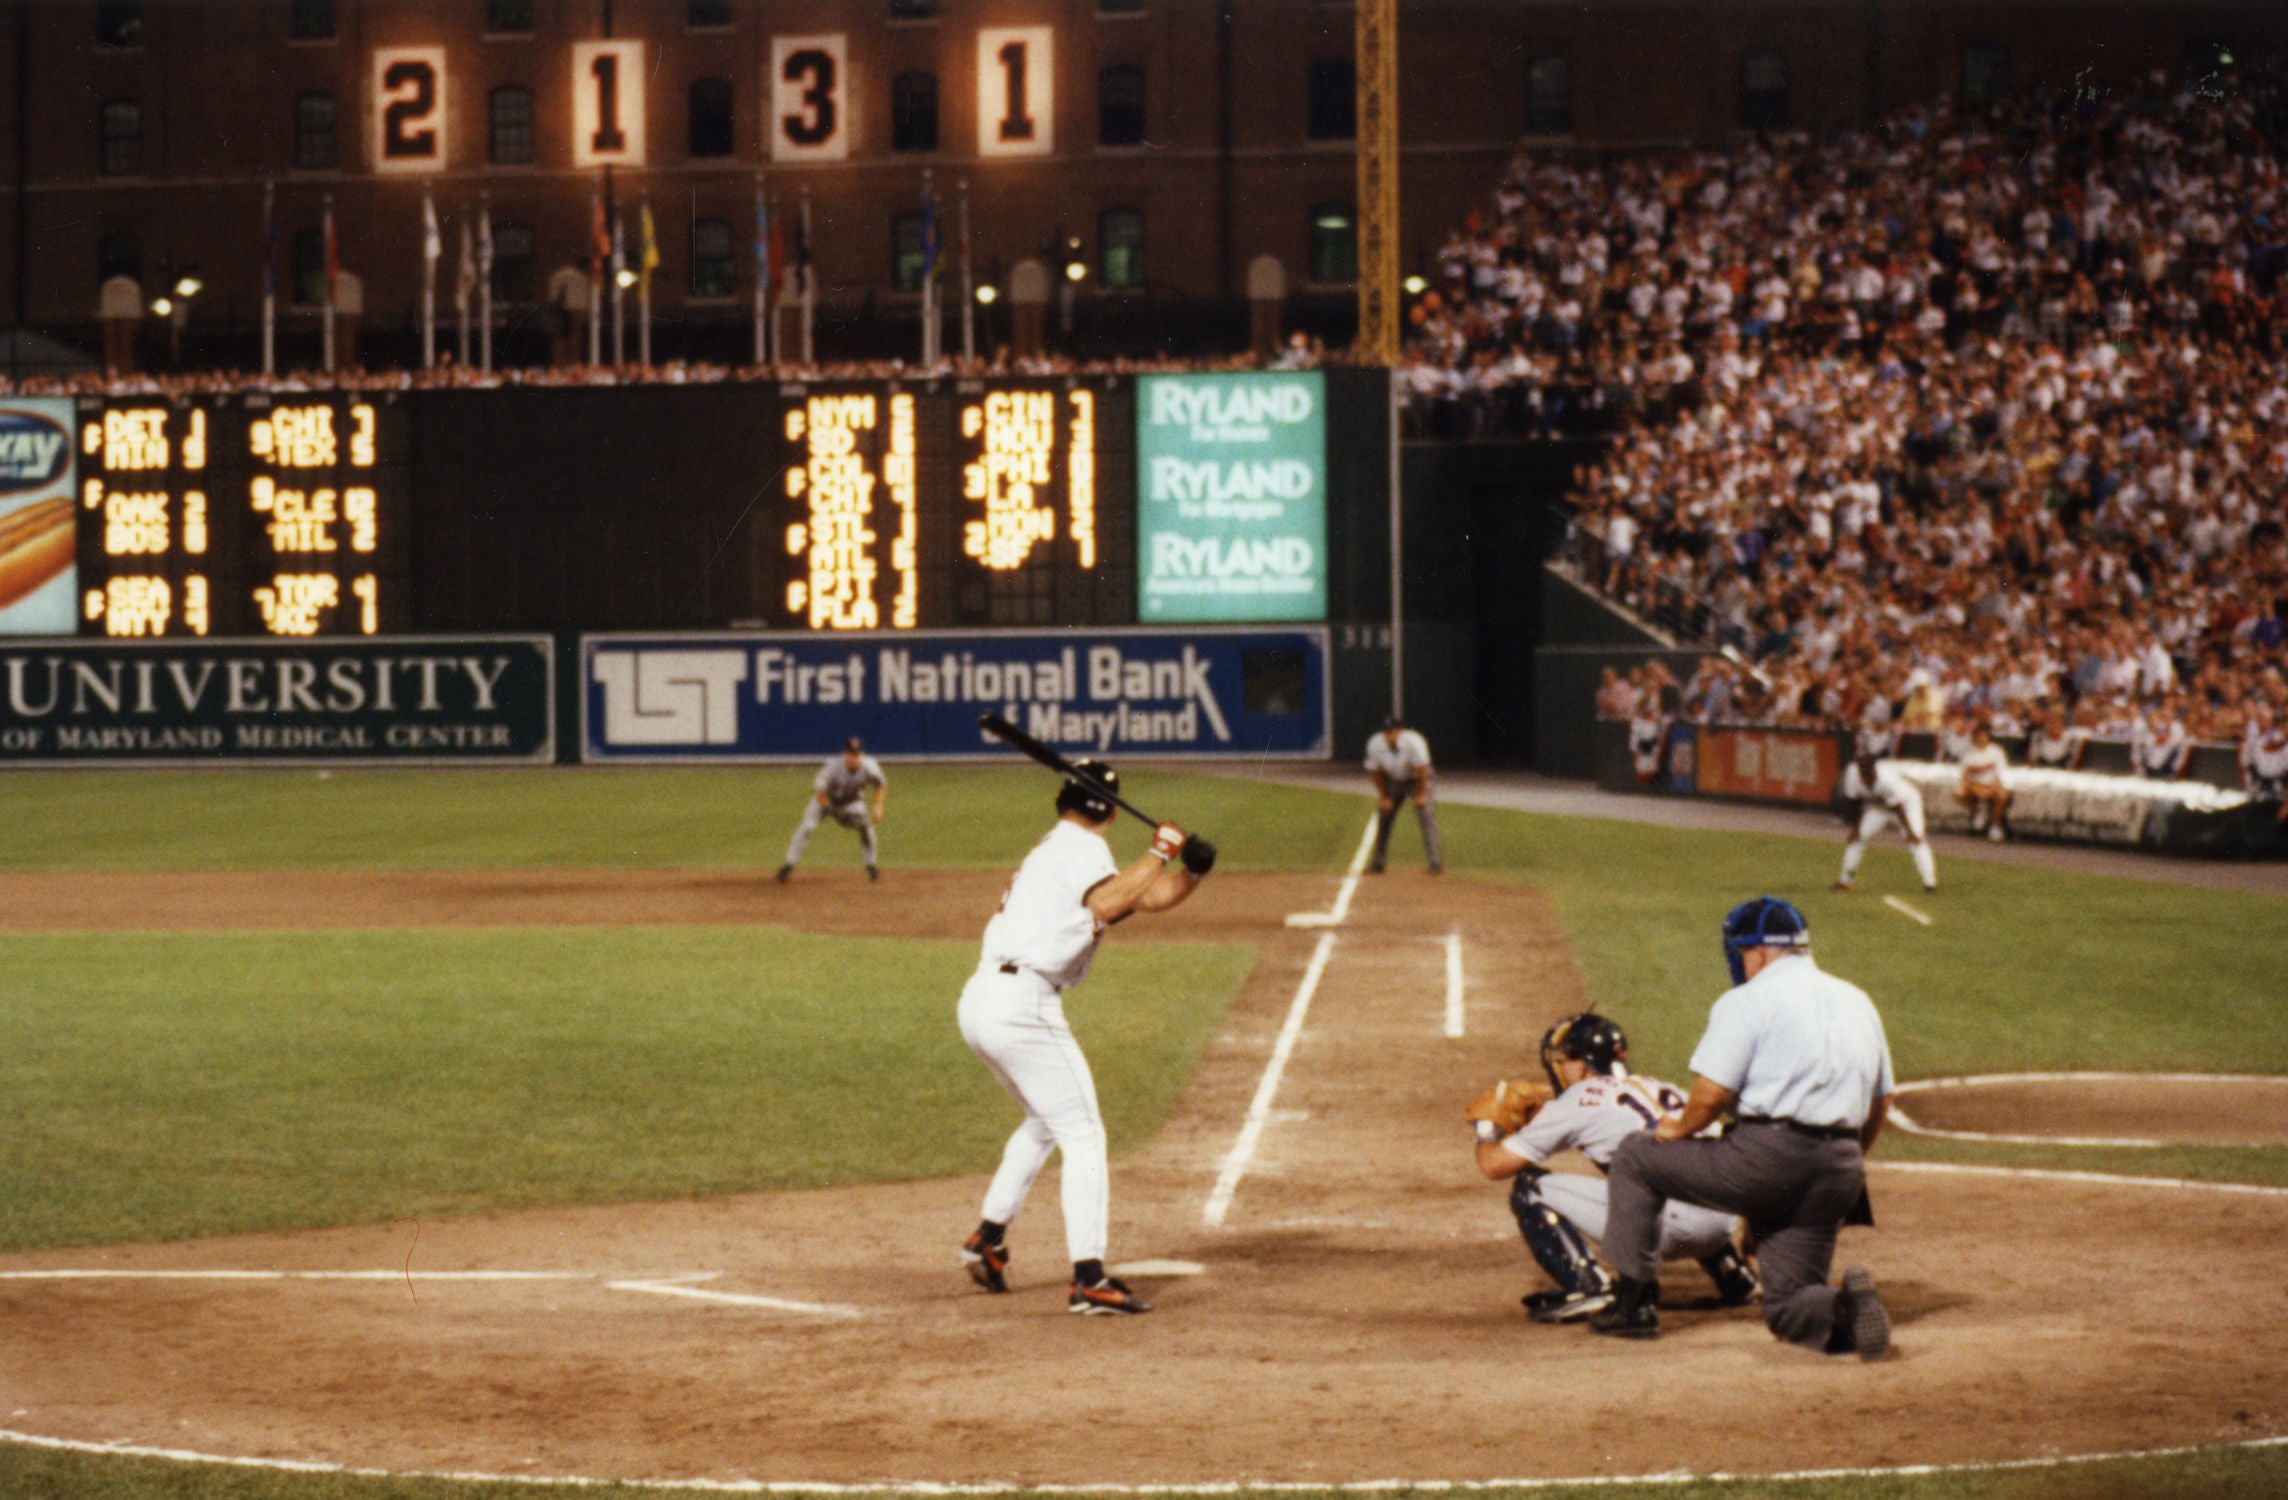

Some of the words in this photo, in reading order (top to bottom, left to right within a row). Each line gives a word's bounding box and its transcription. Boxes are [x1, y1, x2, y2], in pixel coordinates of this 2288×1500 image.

[384, 61, 437, 160] 2
[591, 53, 626, 153] 1
[783, 49, 837, 147] 3
[998, 42, 1035, 144] 1
[272, 405, 334, 438] CHI
[808, 395, 875, 428] NYM
[985, 391, 1053, 423] CIN
[105, 409, 168, 440] DET
[985, 421, 1054, 453] HOU
[104, 438, 169, 469] MIN
[276, 437, 337, 466] TEX
[808, 427, 855, 455] SD
[985, 452, 1049, 485] PHI
[105, 492, 169, 525] OAK
[274, 488, 337, 521] CLE
[986, 482, 1034, 512] LA
[105, 523, 169, 555] BOS
[273, 520, 337, 552] MIL
[809, 512, 876, 543] STL
[809, 541, 876, 572] ATL
[273, 574, 338, 607] TOR
[809, 569, 877, 601] PIT
[272, 604, 319, 635] KC
[809, 598, 878, 629] FLA
[6, 657, 512, 716] UNIVERSITY
[755, 649, 863, 703] First
[878, 644, 1076, 702] National
[1088, 644, 1232, 742] Bank
[1028, 701, 1198, 751] Maryland
